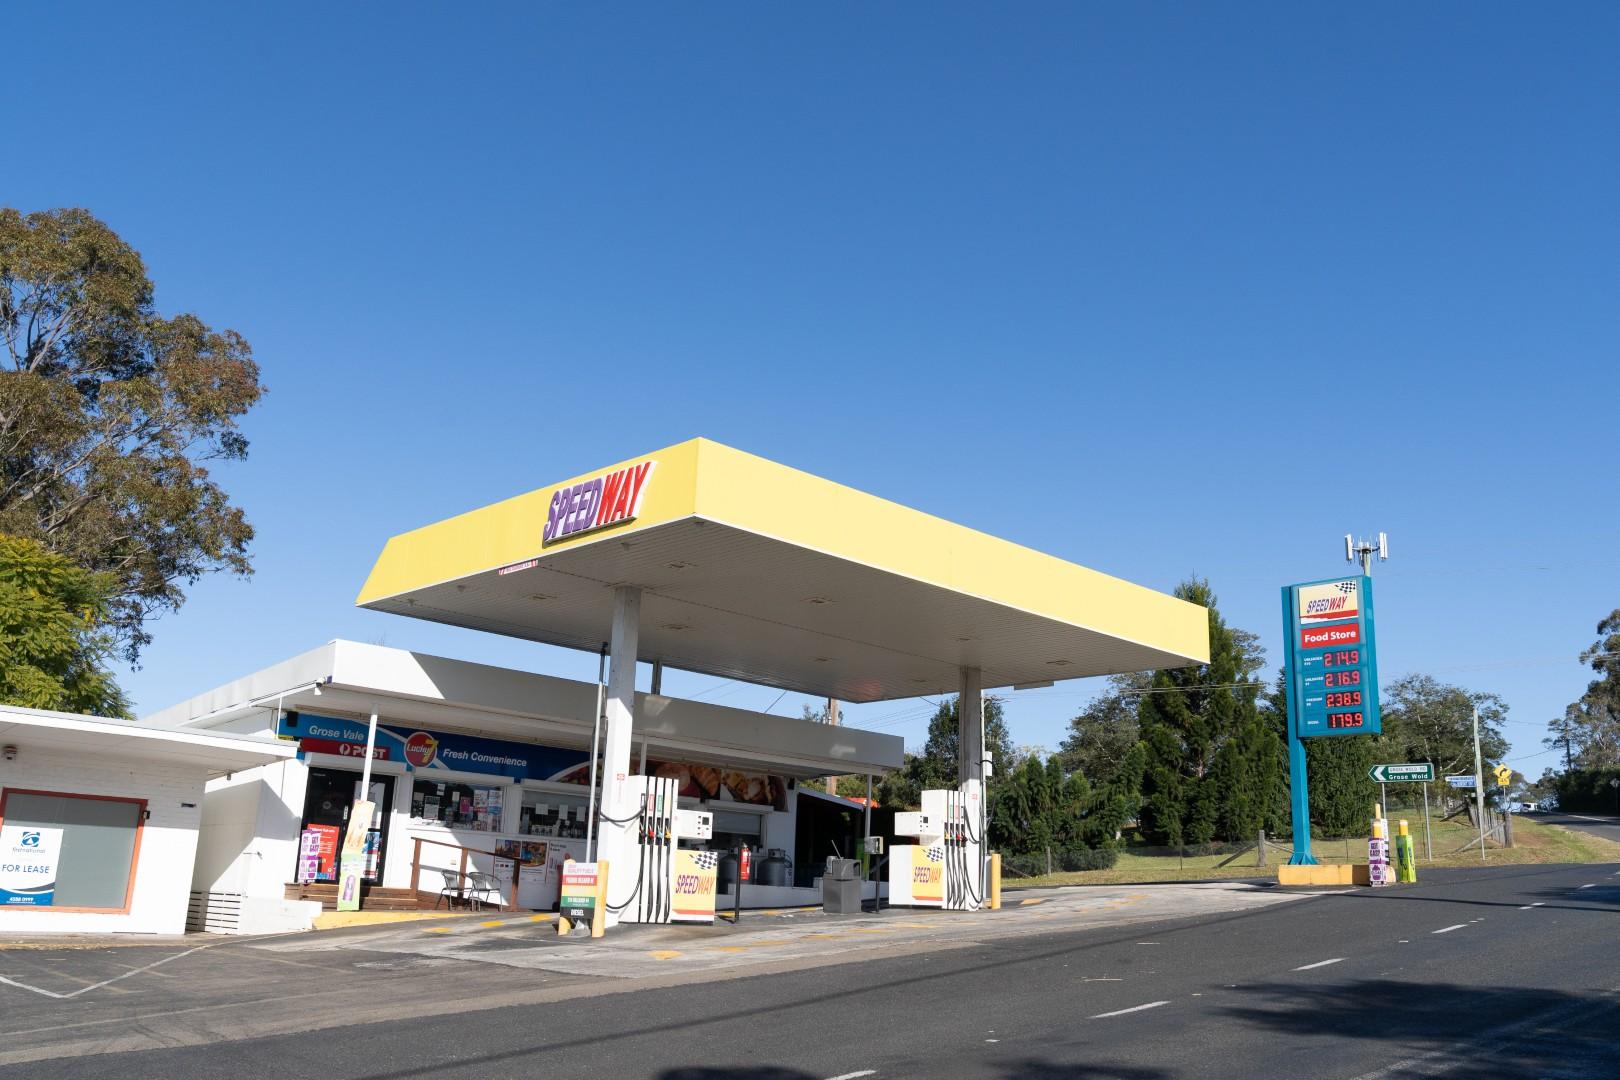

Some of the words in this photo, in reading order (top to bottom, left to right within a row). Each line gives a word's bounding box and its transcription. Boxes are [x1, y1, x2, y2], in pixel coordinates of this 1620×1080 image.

[543, 461, 653, 541] SPEEDWAY
[1306, 595, 1347, 614] SPEEDWAY
[1304, 632, 1329, 643] Food
[1330, 630, 1356, 640] Store
[1324, 650, 1359, 667] 214.9
[1325, 670, 1360, 687] 216.9
[1326, 691, 1361, 708] 238.9
[1330, 713, 1363, 728] 179.9
[308, 725, 341, 738] Grose
[343, 729, 365, 741] Vale
[406, 743, 431, 757] Lucky
[422, 738, 439, 764] 7
[442, 748, 469, 761] Fresh
[470, 751, 528, 767] Convenience
[1, 864, 21, 873] FOR
[23, 865, 50, 874] LEASE
[913, 866, 942, 884] SPEEDWAY
[675, 874, 715, 895] SPEEDWAY
